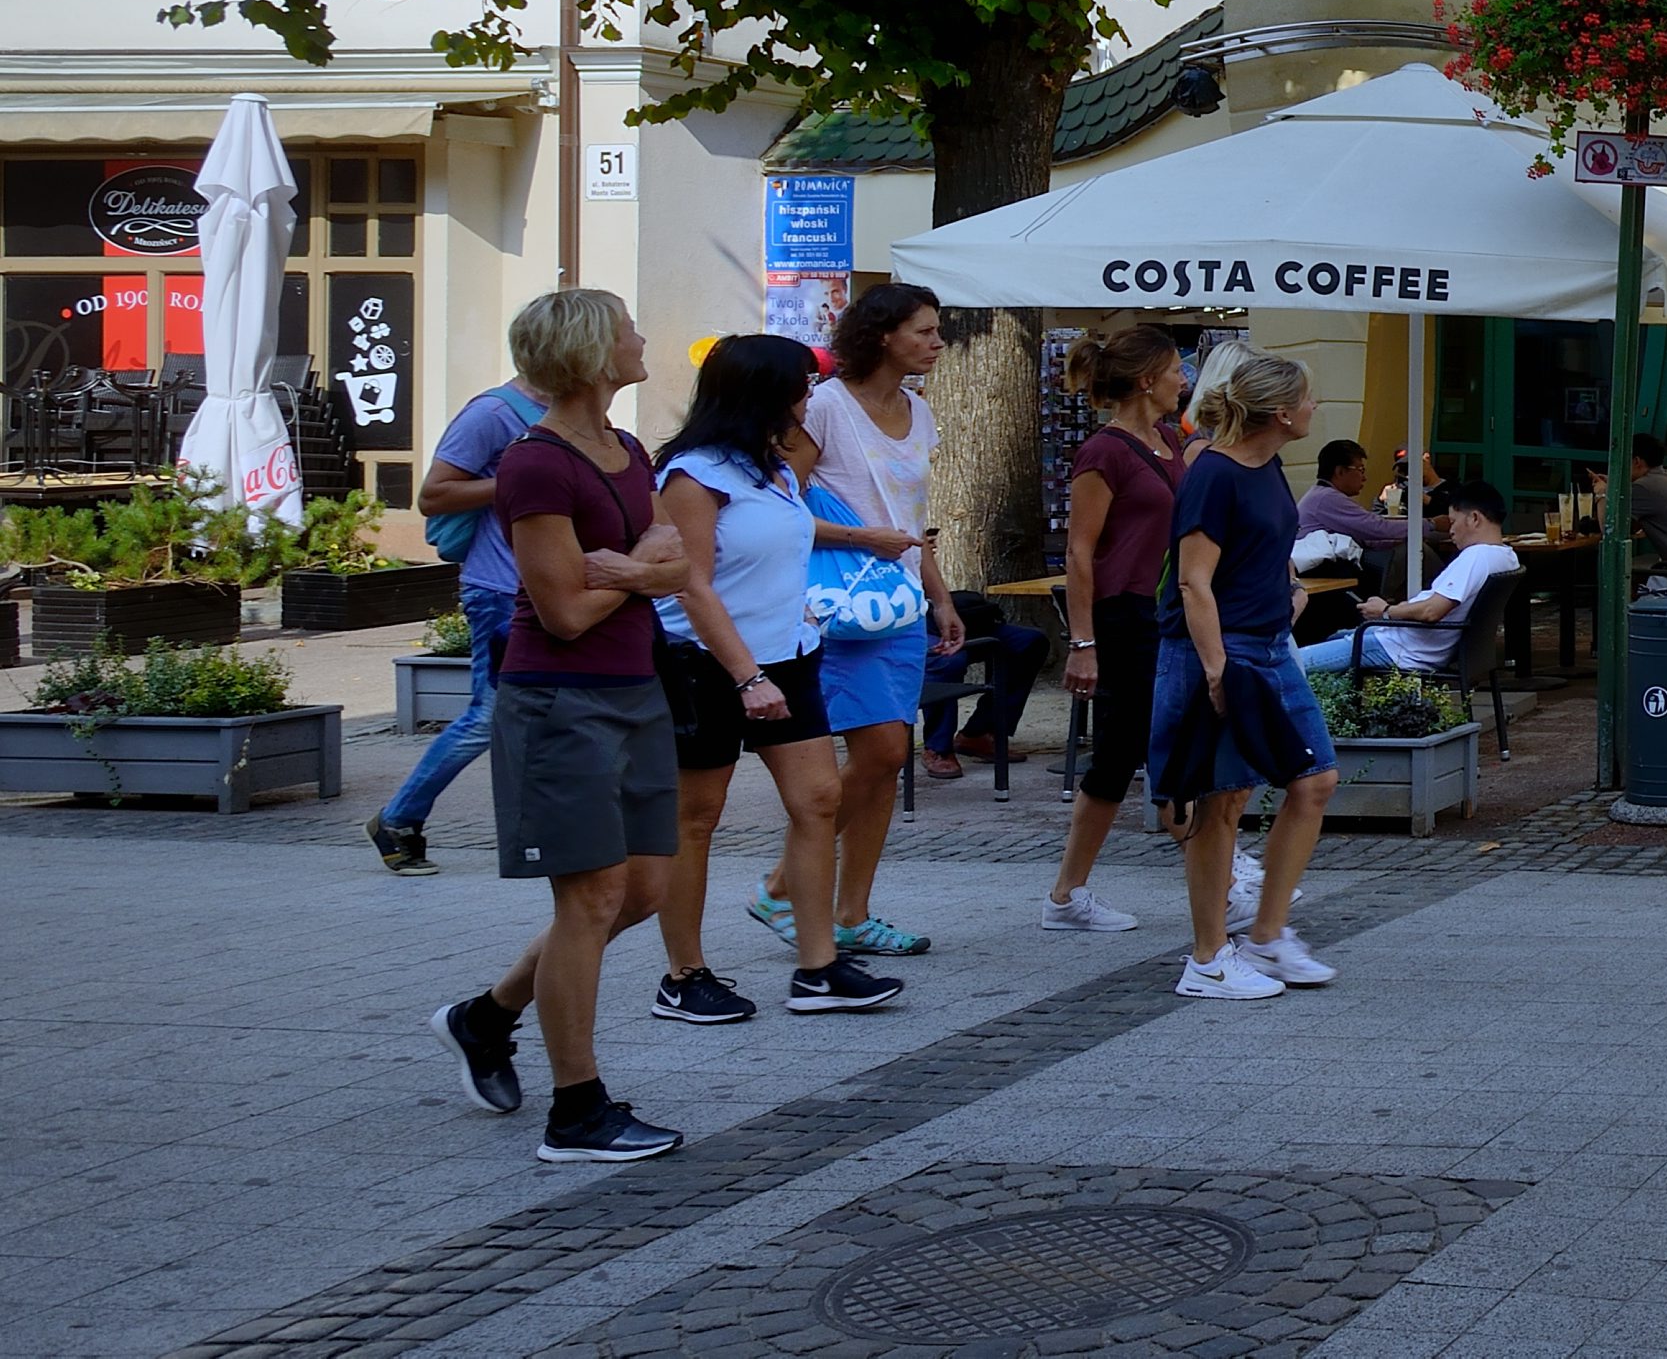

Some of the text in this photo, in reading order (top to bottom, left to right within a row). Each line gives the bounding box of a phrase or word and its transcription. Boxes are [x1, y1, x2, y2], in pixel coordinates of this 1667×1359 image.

[600, 151, 623, 175] 51
[794, 178, 848, 191] ROMANICA
[779, 204, 840, 216] hiszpański
[791, 218, 828, 229] włoski
[782, 232, 837, 243] francuski
[773, 259, 847, 269] www.romanica.pl
[1102, 260, 1450, 302] COSTA COFFEE
[76, 290, 204, 317] OD 190 RO
[769, 297, 805, 312] Twoja
[768, 314, 809, 326] Szkoła
